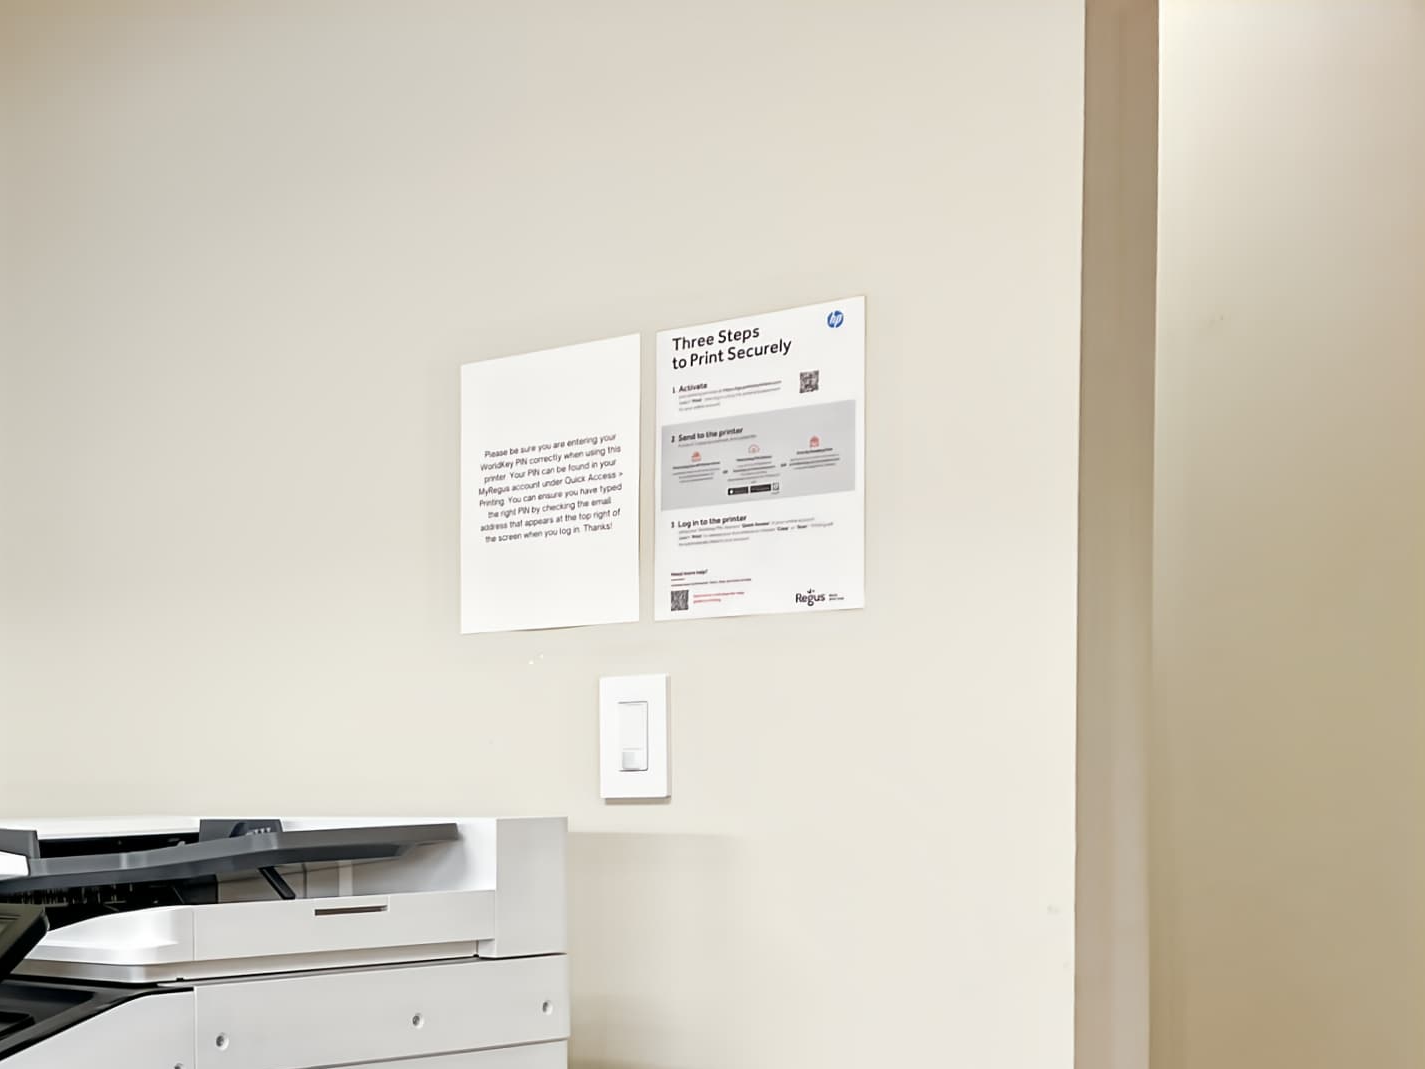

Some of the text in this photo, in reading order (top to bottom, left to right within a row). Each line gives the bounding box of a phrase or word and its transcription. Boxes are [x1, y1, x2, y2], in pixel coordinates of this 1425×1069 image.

[827, 311, 844, 328] hp
[672, 327, 760, 351] Three Steps
[672, 339, 792, 369] to Print Securely
[679, 383, 707, 392] Activate
[698, 431, 705, 439] to
[485, 450, 508, 458] Please
[521, 445, 535, 453] sure
[538, 444, 551, 452] you
[553, 441, 565, 449] are
[567, 436, 598, 446] entering
[599, 434, 616, 443] your
[515, 457, 527, 465] PIN
[529, 453, 561, 464] correctly
[564, 451, 583, 459] when
[586, 448, 606, 457] using
[509, 471, 525, 480] Your
[528, 468, 539, 476] PIN
[542, 466, 554, 475] can
[557, 464, 566, 472] be
[568, 461, 589, 471] found
[600, 460, 616, 469] your
[512, 482, 540, 491] account
[542, 478, 563, 487] under
[565, 475, 585, 484] Quick
[588, 472, 616, 481] Access
[508, 496, 521, 504] You
[538, 490, 563, 500] ensure
[565, 489, 578, 498] you
[580, 487, 597, 495] have
[600, 484, 622, 494] typed
[488, 510, 498, 518] the
[501, 508, 516, 518] right
[531, 506, 540, 514] by
[542, 501, 575, 512] checking
[591, 497, 611, 506] email
[480, 523, 507, 531] address
[509, 520, 522, 528] that
[525, 518, 553, 527] appears
[556, 515, 563, 523] at
[579, 512, 591, 521] top
[594, 510, 610, 520] right
[612, 508, 620, 517] of
[498, 532, 522, 542] screen
[544, 529, 557, 538] you
[560, 527, 571, 536] log
[796, 588, 825, 606] Regus
